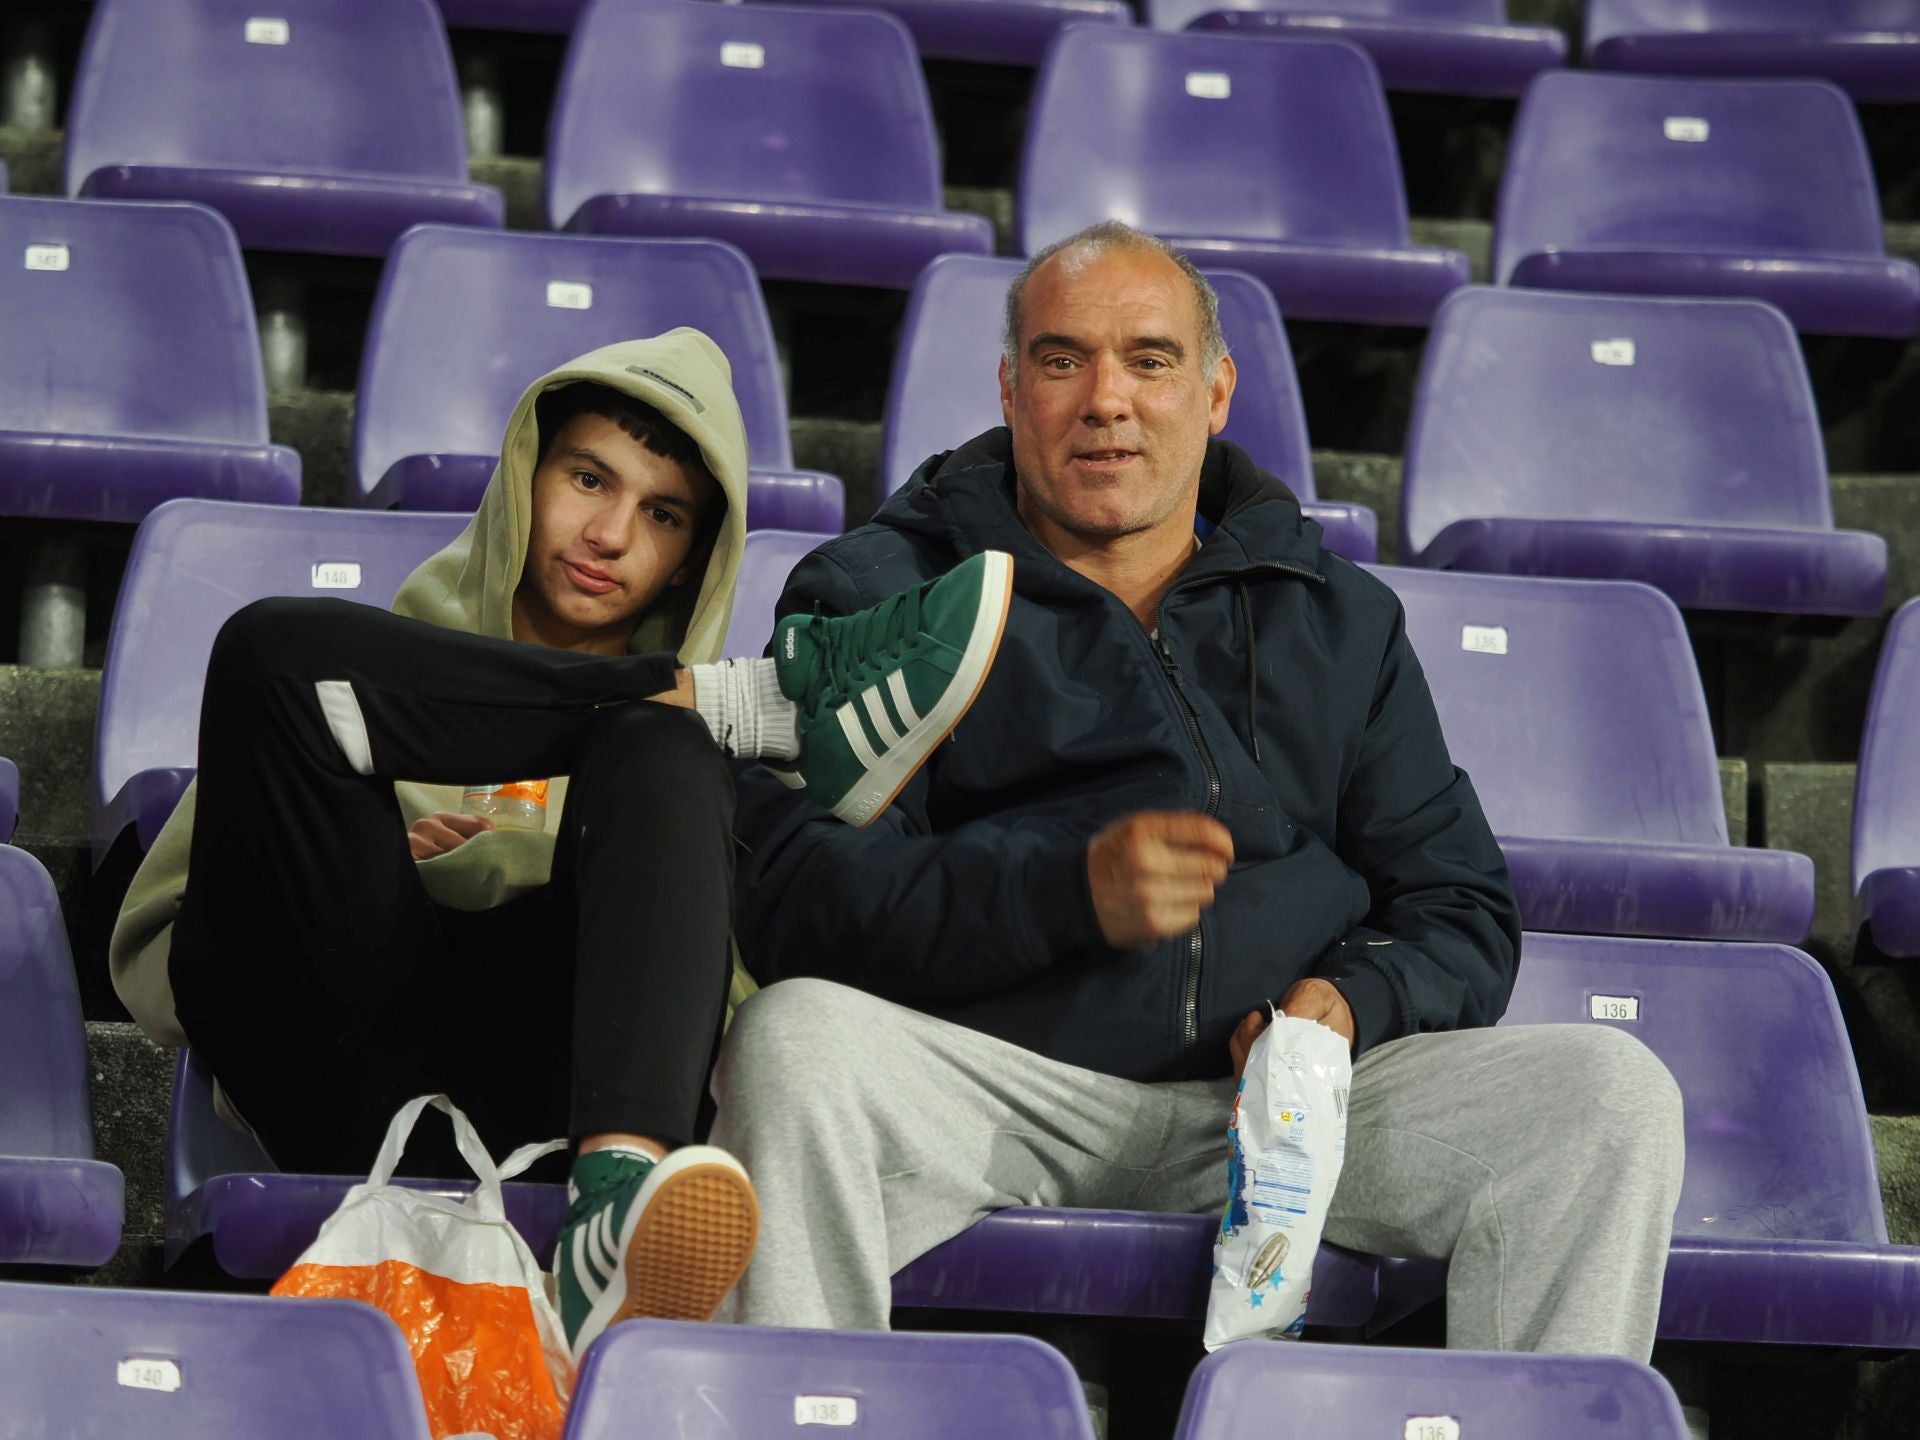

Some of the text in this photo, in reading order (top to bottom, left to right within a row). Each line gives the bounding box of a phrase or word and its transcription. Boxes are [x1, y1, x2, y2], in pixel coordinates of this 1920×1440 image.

[324, 567, 347, 584] 140
[785, 627, 795, 659] adidas
[1602, 1003, 1627, 1019] 136
[134, 1368, 163, 1386] 140
[810, 1403, 838, 1421] 138
[1416, 1426, 1445, 1440] 136
